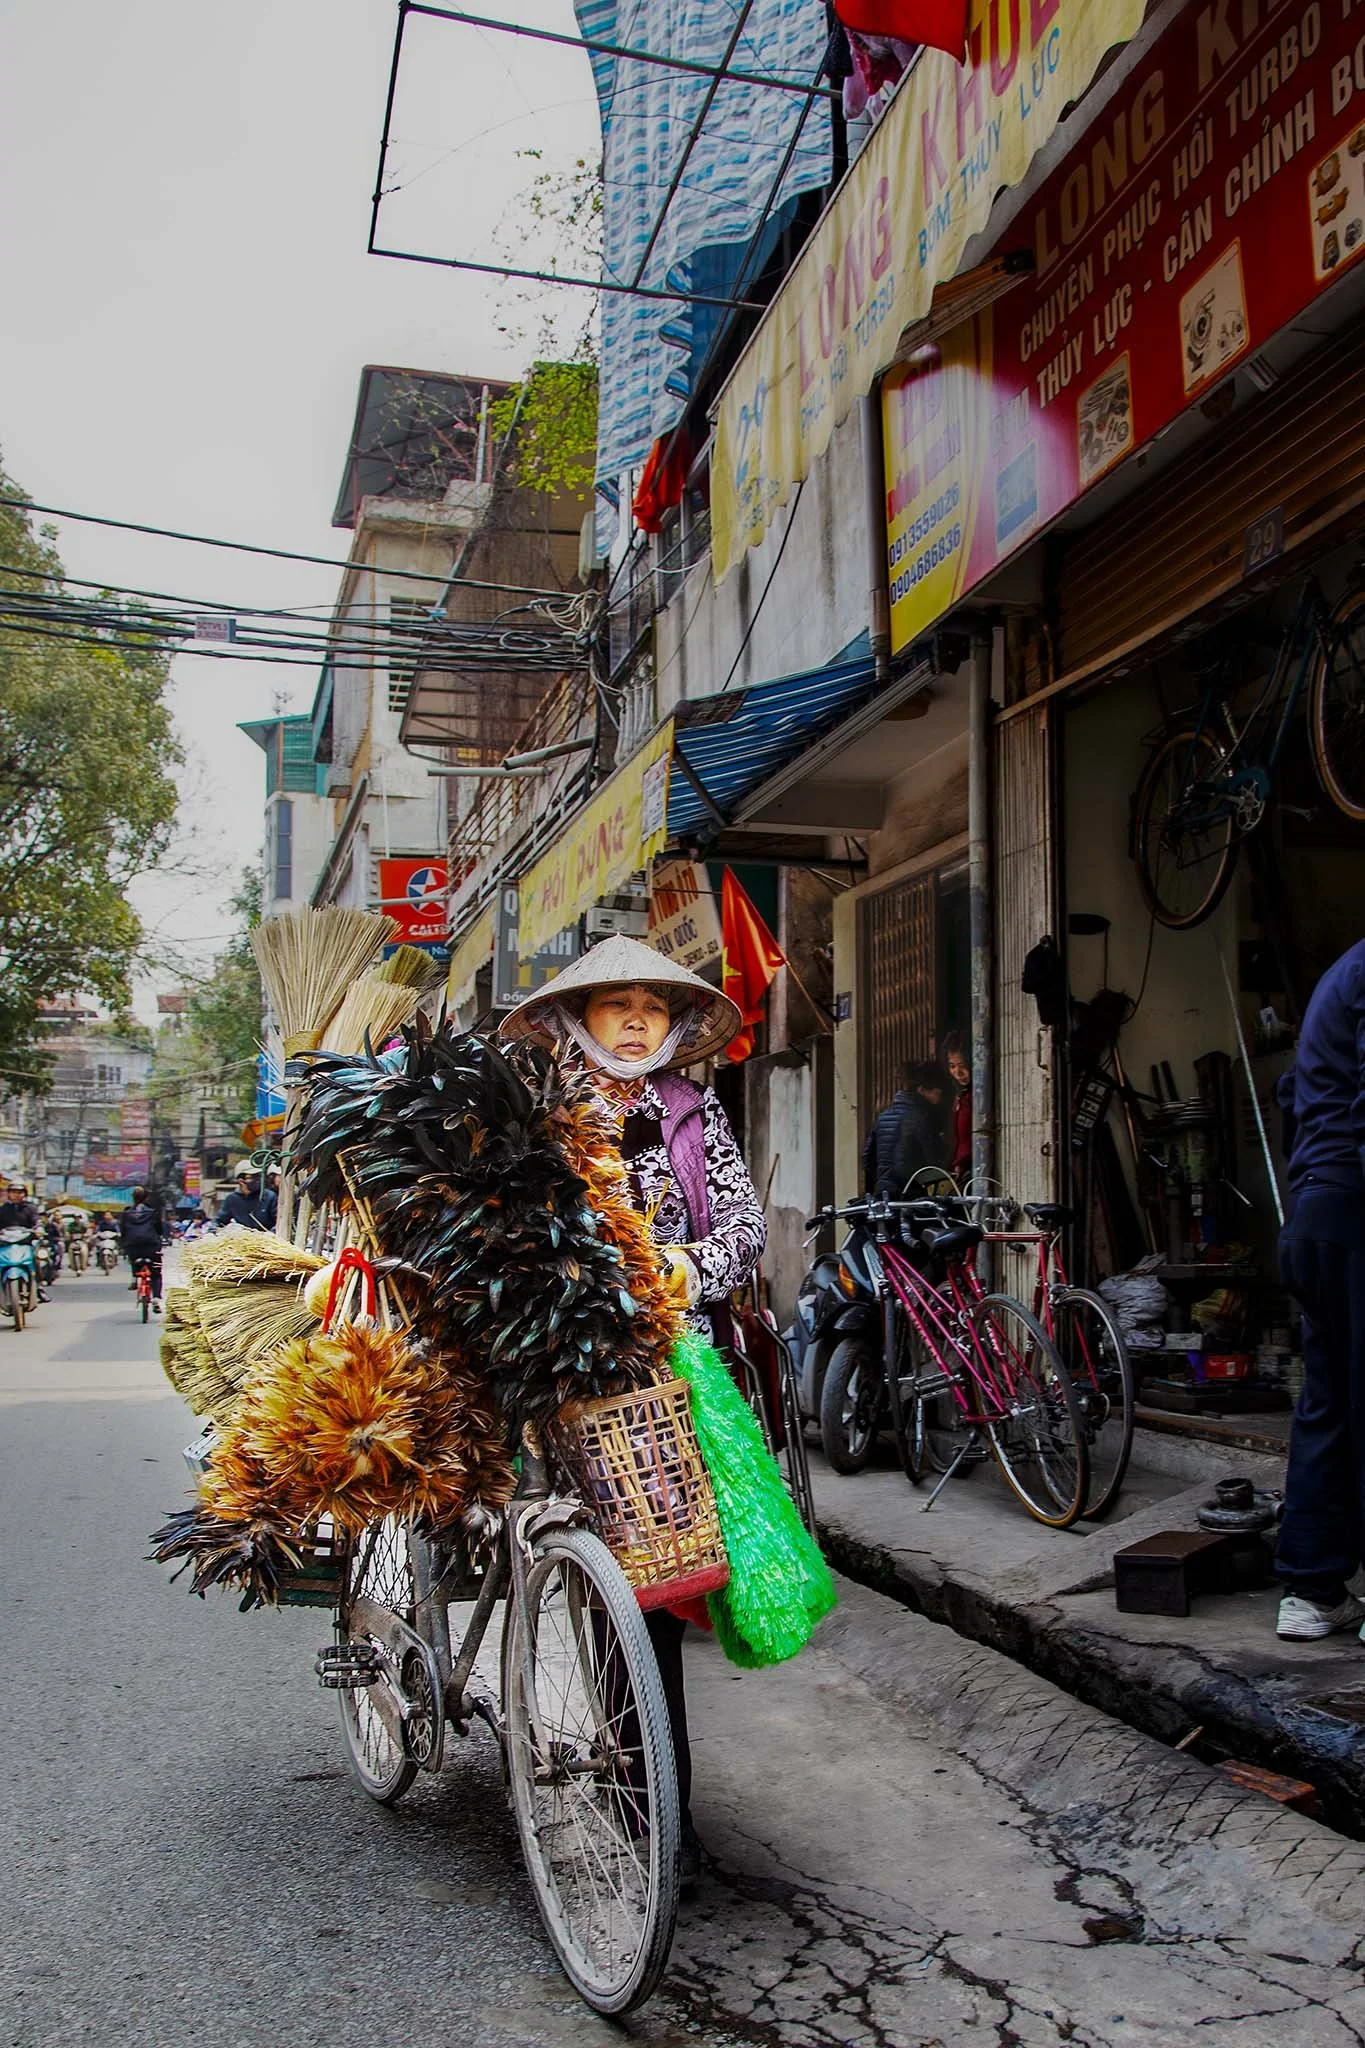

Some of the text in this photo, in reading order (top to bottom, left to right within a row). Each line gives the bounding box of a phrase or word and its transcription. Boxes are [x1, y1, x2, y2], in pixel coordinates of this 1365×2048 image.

[1020, 2, 1321, 362] CHUYÊN PHỤC HỒI TURBO
[1035, 0, 1272, 279] LONG K
[799, 176, 892, 397] LONG
[1036, 329, 1083, 411] THỦY
[1093, 283, 1133, 357] LỰC
[1143, 279, 1153, 293] -
[1163, 196, 1213, 283] CÂN
[1224, 90, 1316, 218] CHỈNH
[854, 273, 895, 356] TURBO
[889, 481, 960, 570] 0913559026
[890, 521, 961, 607] 0904686836
[1249, 519, 1276, 566] 29
[408, 924, 449, 936] CALTE
[674, 915, 698, 948] QUỐC
